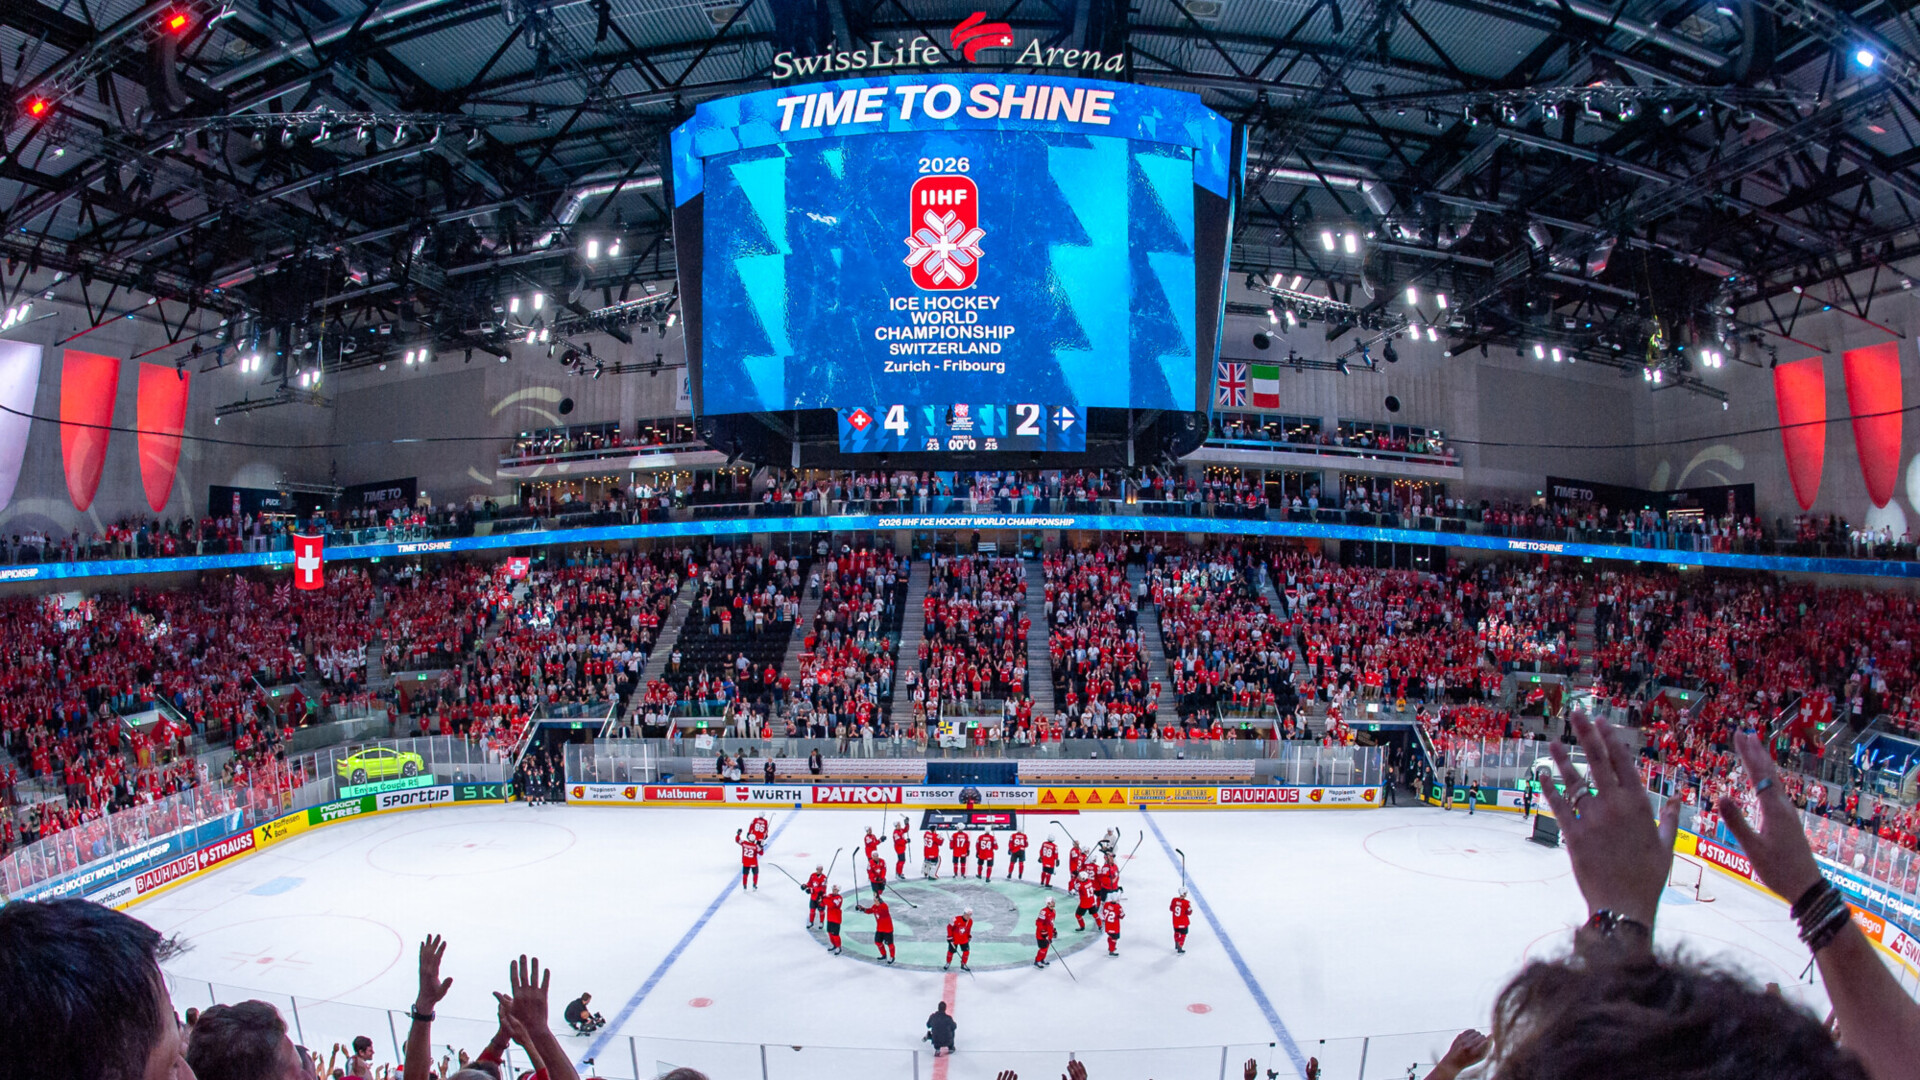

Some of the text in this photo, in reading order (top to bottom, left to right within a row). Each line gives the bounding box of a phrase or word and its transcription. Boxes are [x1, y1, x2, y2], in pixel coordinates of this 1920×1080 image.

[1015, 38, 1125, 73] Arena
[777, 83, 1115, 132] TIME TO SHINE
[918, 157, 970, 173] 2026
[920, 189, 967, 206] IIHF
[889, 296, 1000, 311] ICE HOCKEY
[910, 310, 978, 325] WORLD
[874, 325, 1016, 340] CHAMPIONSHIP
[889, 342, 1001, 355] SWITZERLAND
[883, 360, 931, 373] Zurich
[943, 359, 1005, 374] Fribourg
[883, 404, 909, 436] 4
[1015, 404, 1040, 436] 2
[927, 442, 940, 451] 23
[984, 442, 998, 451] 25
[363, 487, 402, 503] TIME TO
[1553, 485, 1593, 501] TIME TO
[878, 517, 1075, 527] 2026 IIHF ICE HOCKEY WORLD CHAMPIONSHIP
[398, 541, 452, 553] TIME TO SHINE
[1508, 540, 1563, 552] TIME TO SHINE
[656, 788, 708, 800] Malbuner
[752, 789, 802, 800] WÜRTH
[816, 786, 898, 803] PATRON
[920, 790, 955, 798] TISSOT
[1222, 788, 1300, 803] BAUHAUS
[320, 798, 362, 813] nokian
[321, 805, 362, 821] TYRES
[274, 826, 288, 838] Bank
[754, 823, 766, 833] 86
[208, 833, 253, 862] STRAUSS
[956, 838, 966, 848] 17
[980, 840, 992, 850] 54
[743, 848, 755, 858] 22
[1706, 844, 1751, 875] STRAUSS
[53, 883, 66, 896] ICE
[66, 871, 98, 893] HOCKEY
[96, 861, 120, 884] WORLD
[119, 842, 171, 873] CHAMPIONSHIP
[136, 855, 196, 894] BAUHAUS
[1832, 874, 1862, 893] HOCKEY
[1861, 886, 1887, 904] WORLD
[1103, 909, 1116, 922] 72
[1174, 906, 1182, 917] 9
[1853, 911, 1882, 934] allegro
